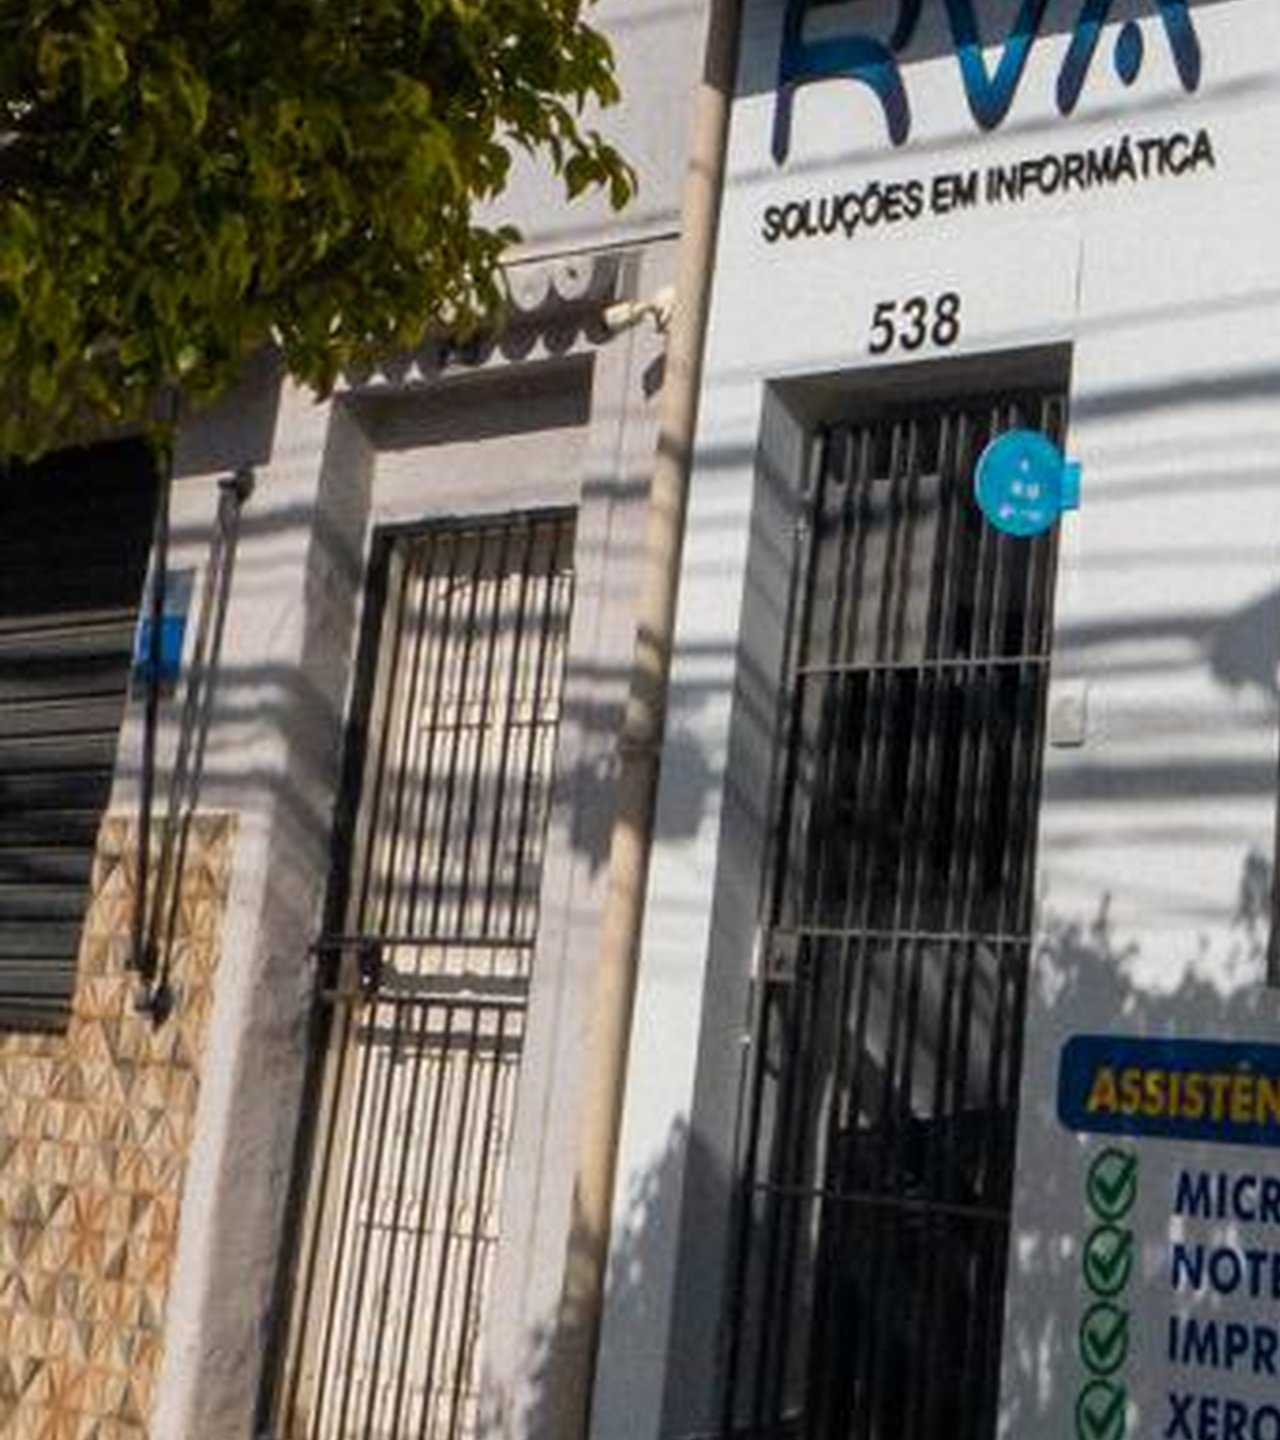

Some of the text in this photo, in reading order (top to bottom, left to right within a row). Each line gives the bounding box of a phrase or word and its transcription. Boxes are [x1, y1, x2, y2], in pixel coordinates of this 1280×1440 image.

[762, 128, 1216, 242] SOLUÇÕES EM INFORMÁTICA
[867, 291, 961, 355] 538
